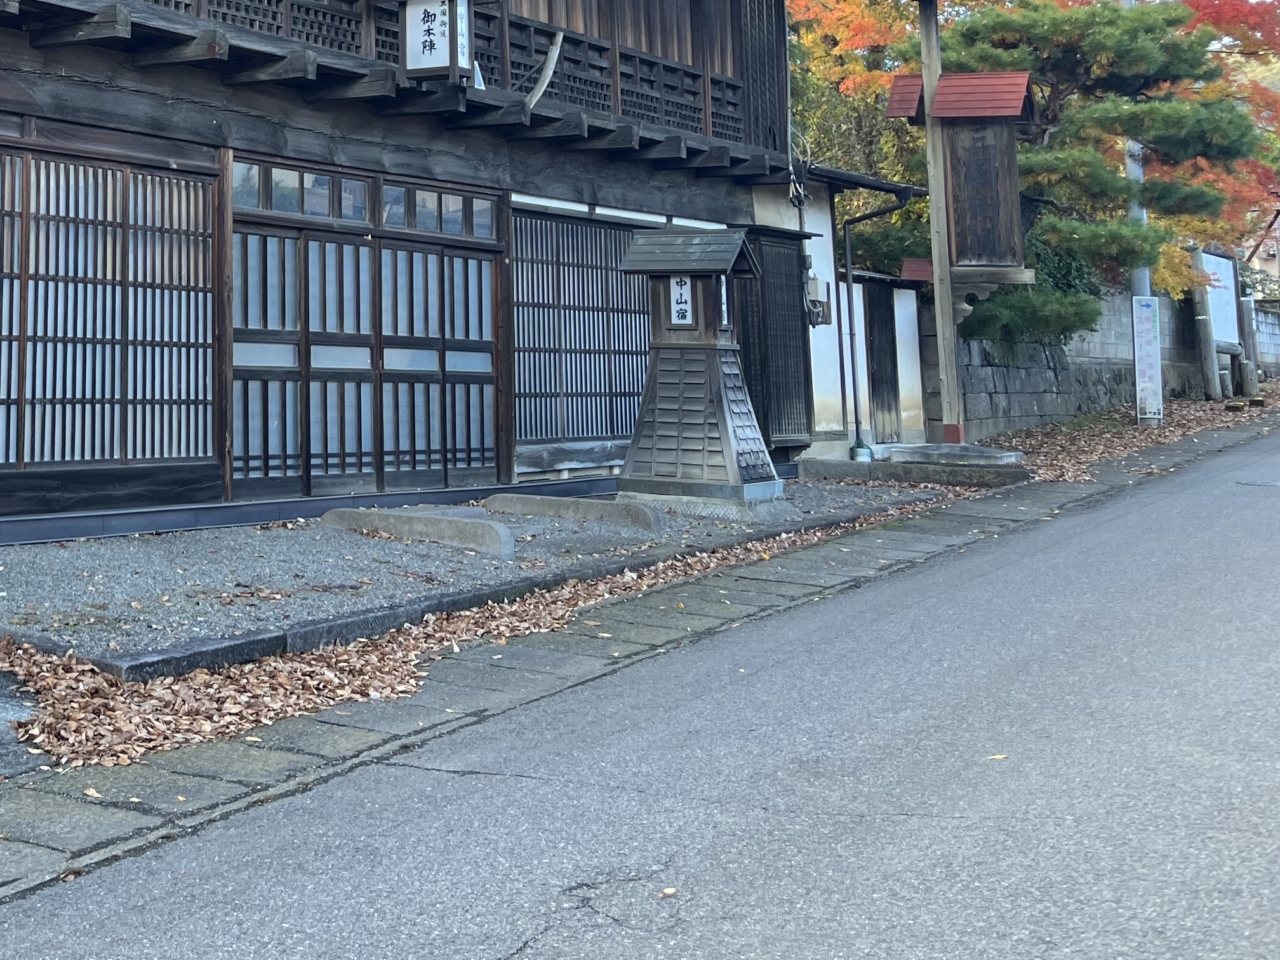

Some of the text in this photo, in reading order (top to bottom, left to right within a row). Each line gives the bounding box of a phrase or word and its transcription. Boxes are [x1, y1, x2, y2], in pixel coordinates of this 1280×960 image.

[421, 8, 437, 56] 御本陣
[675, 277, 688, 321] 中山宿
